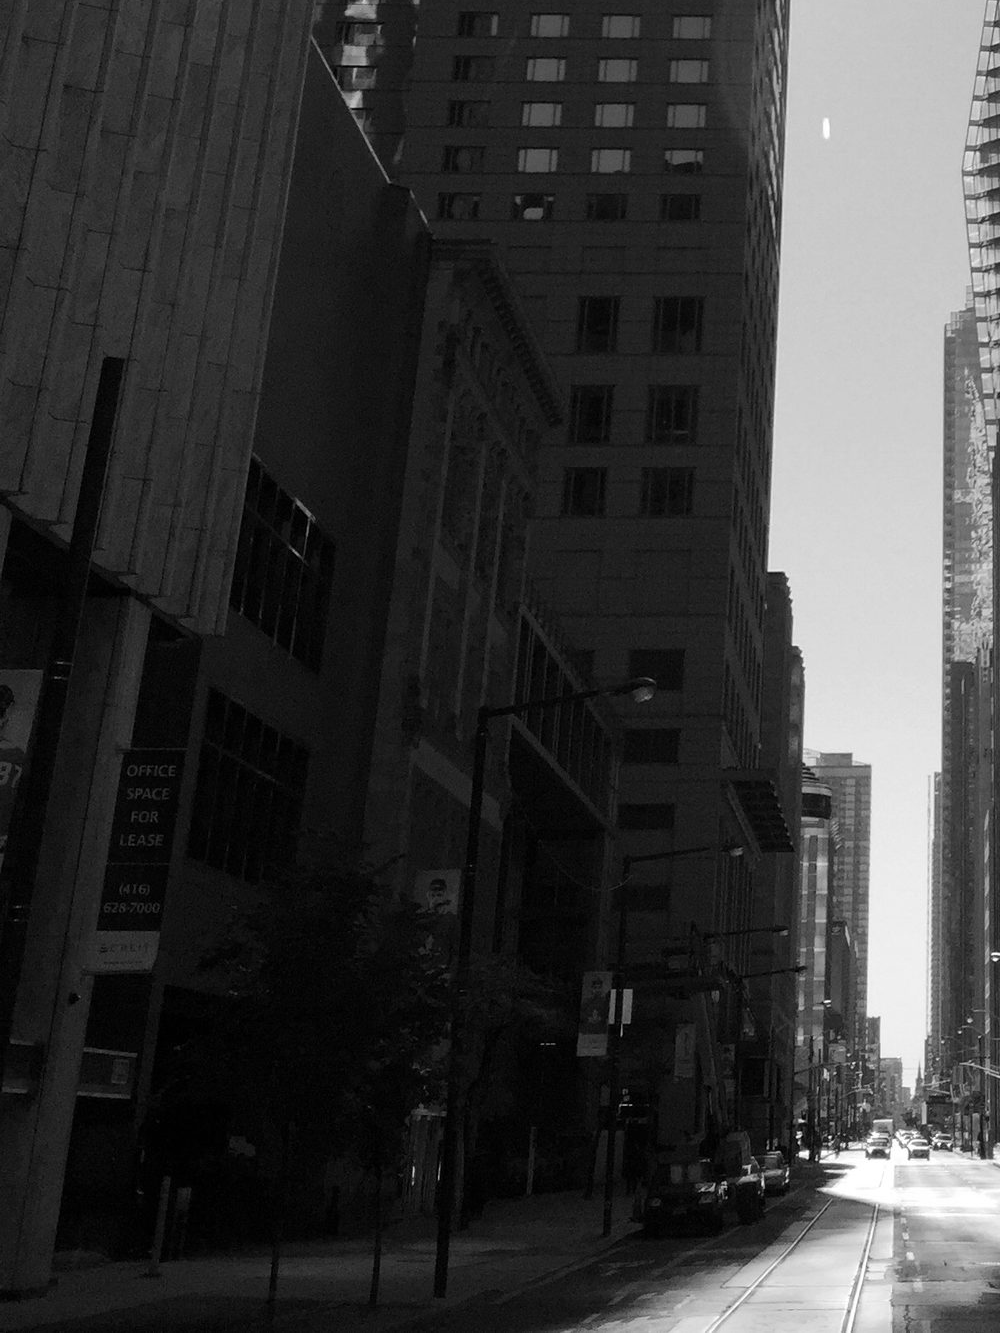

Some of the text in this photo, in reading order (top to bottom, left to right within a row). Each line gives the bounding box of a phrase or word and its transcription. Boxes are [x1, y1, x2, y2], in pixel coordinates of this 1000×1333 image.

[127, 764, 177, 777] OFFICE
[126, 788, 170, 800] SPACE
[130, 811, 159, 823] FOR
[119, 834, 165, 846] LEASE
[119, 883, 151, 895] (416)
[103, 902, 161, 913] 628-7000
